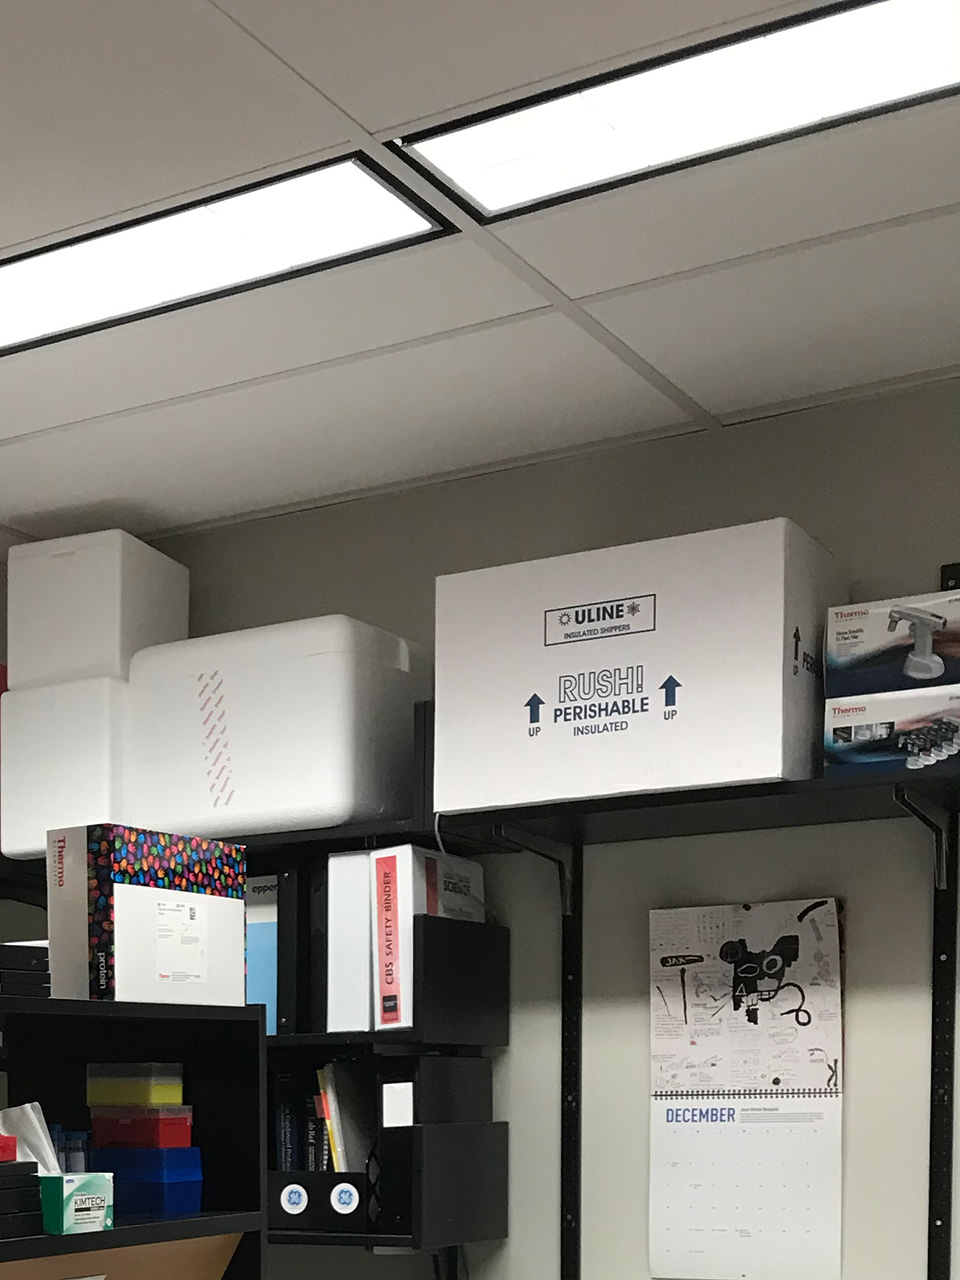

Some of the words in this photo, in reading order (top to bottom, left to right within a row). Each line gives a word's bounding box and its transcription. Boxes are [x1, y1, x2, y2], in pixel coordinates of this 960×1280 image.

[574, 604, 624, 624] ULINE
[835, 610, 869, 618] Thermo
[564, 628, 599, 640] INSULATED
[600, 624, 630, 634] SHIPPERS
[559, 665, 644, 703] RUSH!
[554, 697, 649, 723] PERISHABLE
[664, 710, 677, 720] UP
[832, 706, 866, 715] Thermo
[528, 727, 541, 737] UP
[574, 721, 628, 736] INSULATED
[97, 952, 106, 989] protein
[385, 961, 394, 985] CBS
[666, 1108, 736, 1123] DECEMBER
[74, 1196, 105, 1208] KIMTECH
